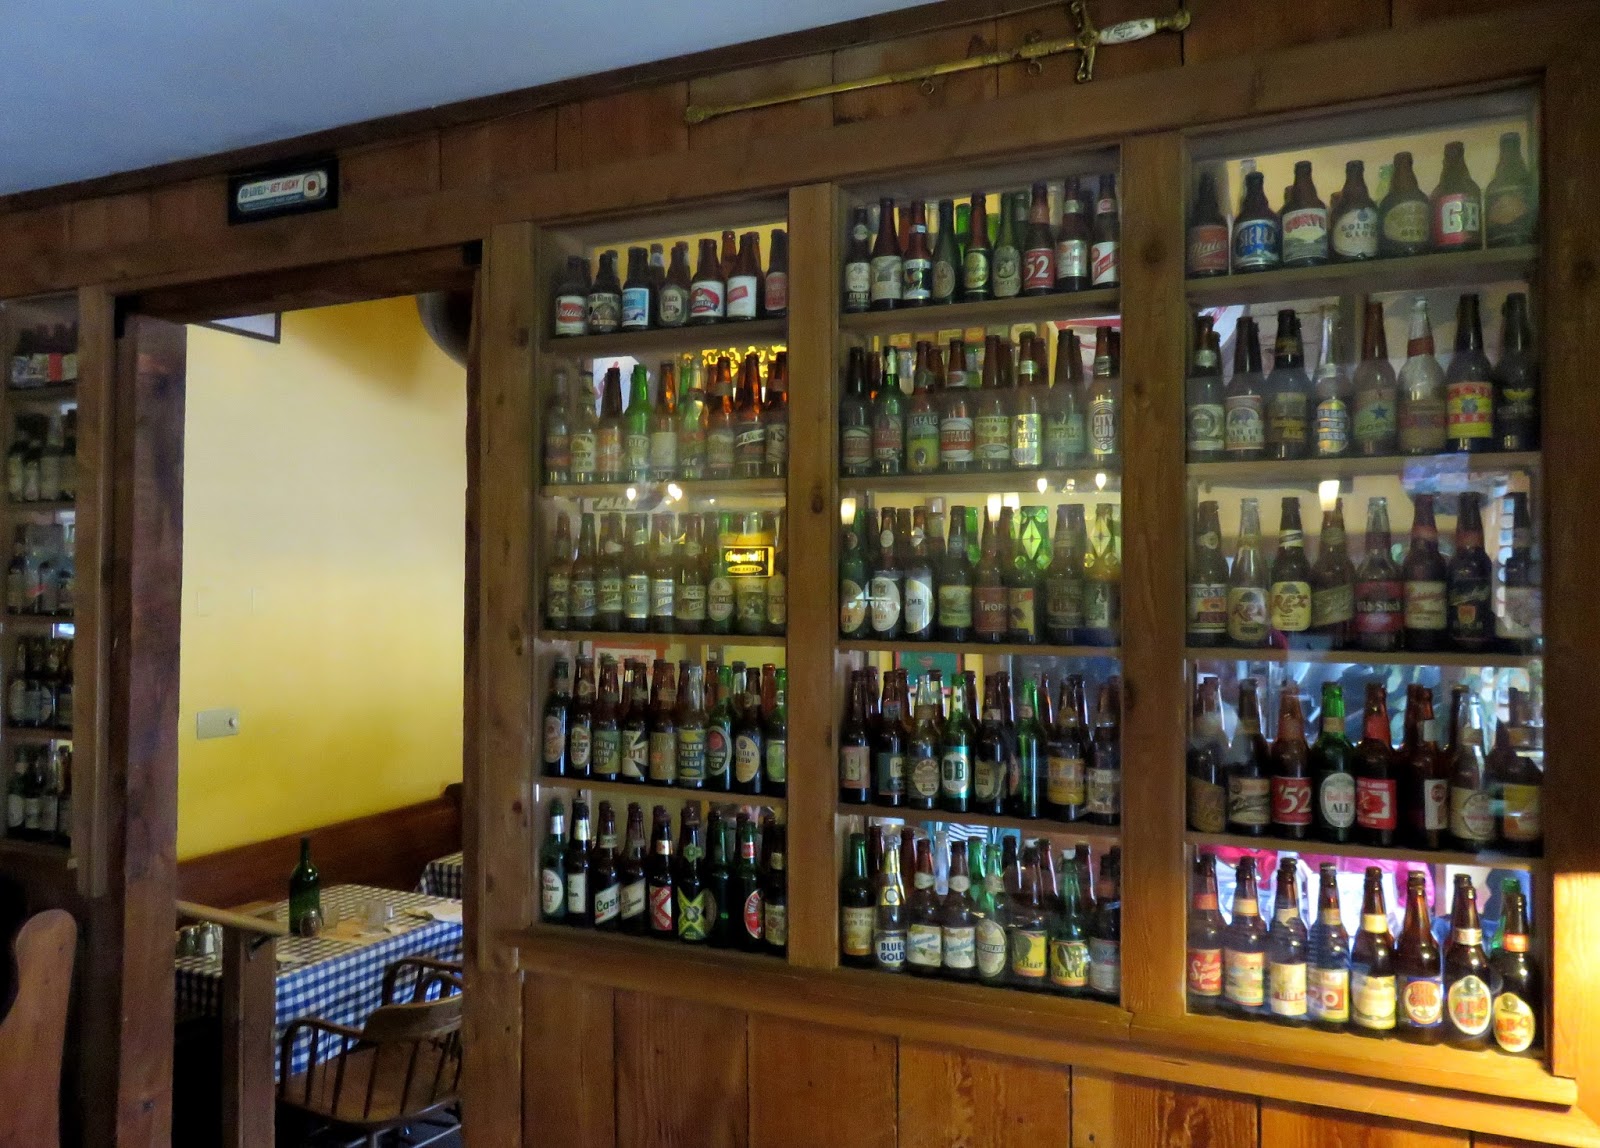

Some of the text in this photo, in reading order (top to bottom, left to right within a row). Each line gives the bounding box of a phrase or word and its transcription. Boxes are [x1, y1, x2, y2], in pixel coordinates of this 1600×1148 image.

[1094, 414, 1113, 426] CITY
[881, 942, 902, 951] BLUE
[880, 951, 905, 961] GOLD
